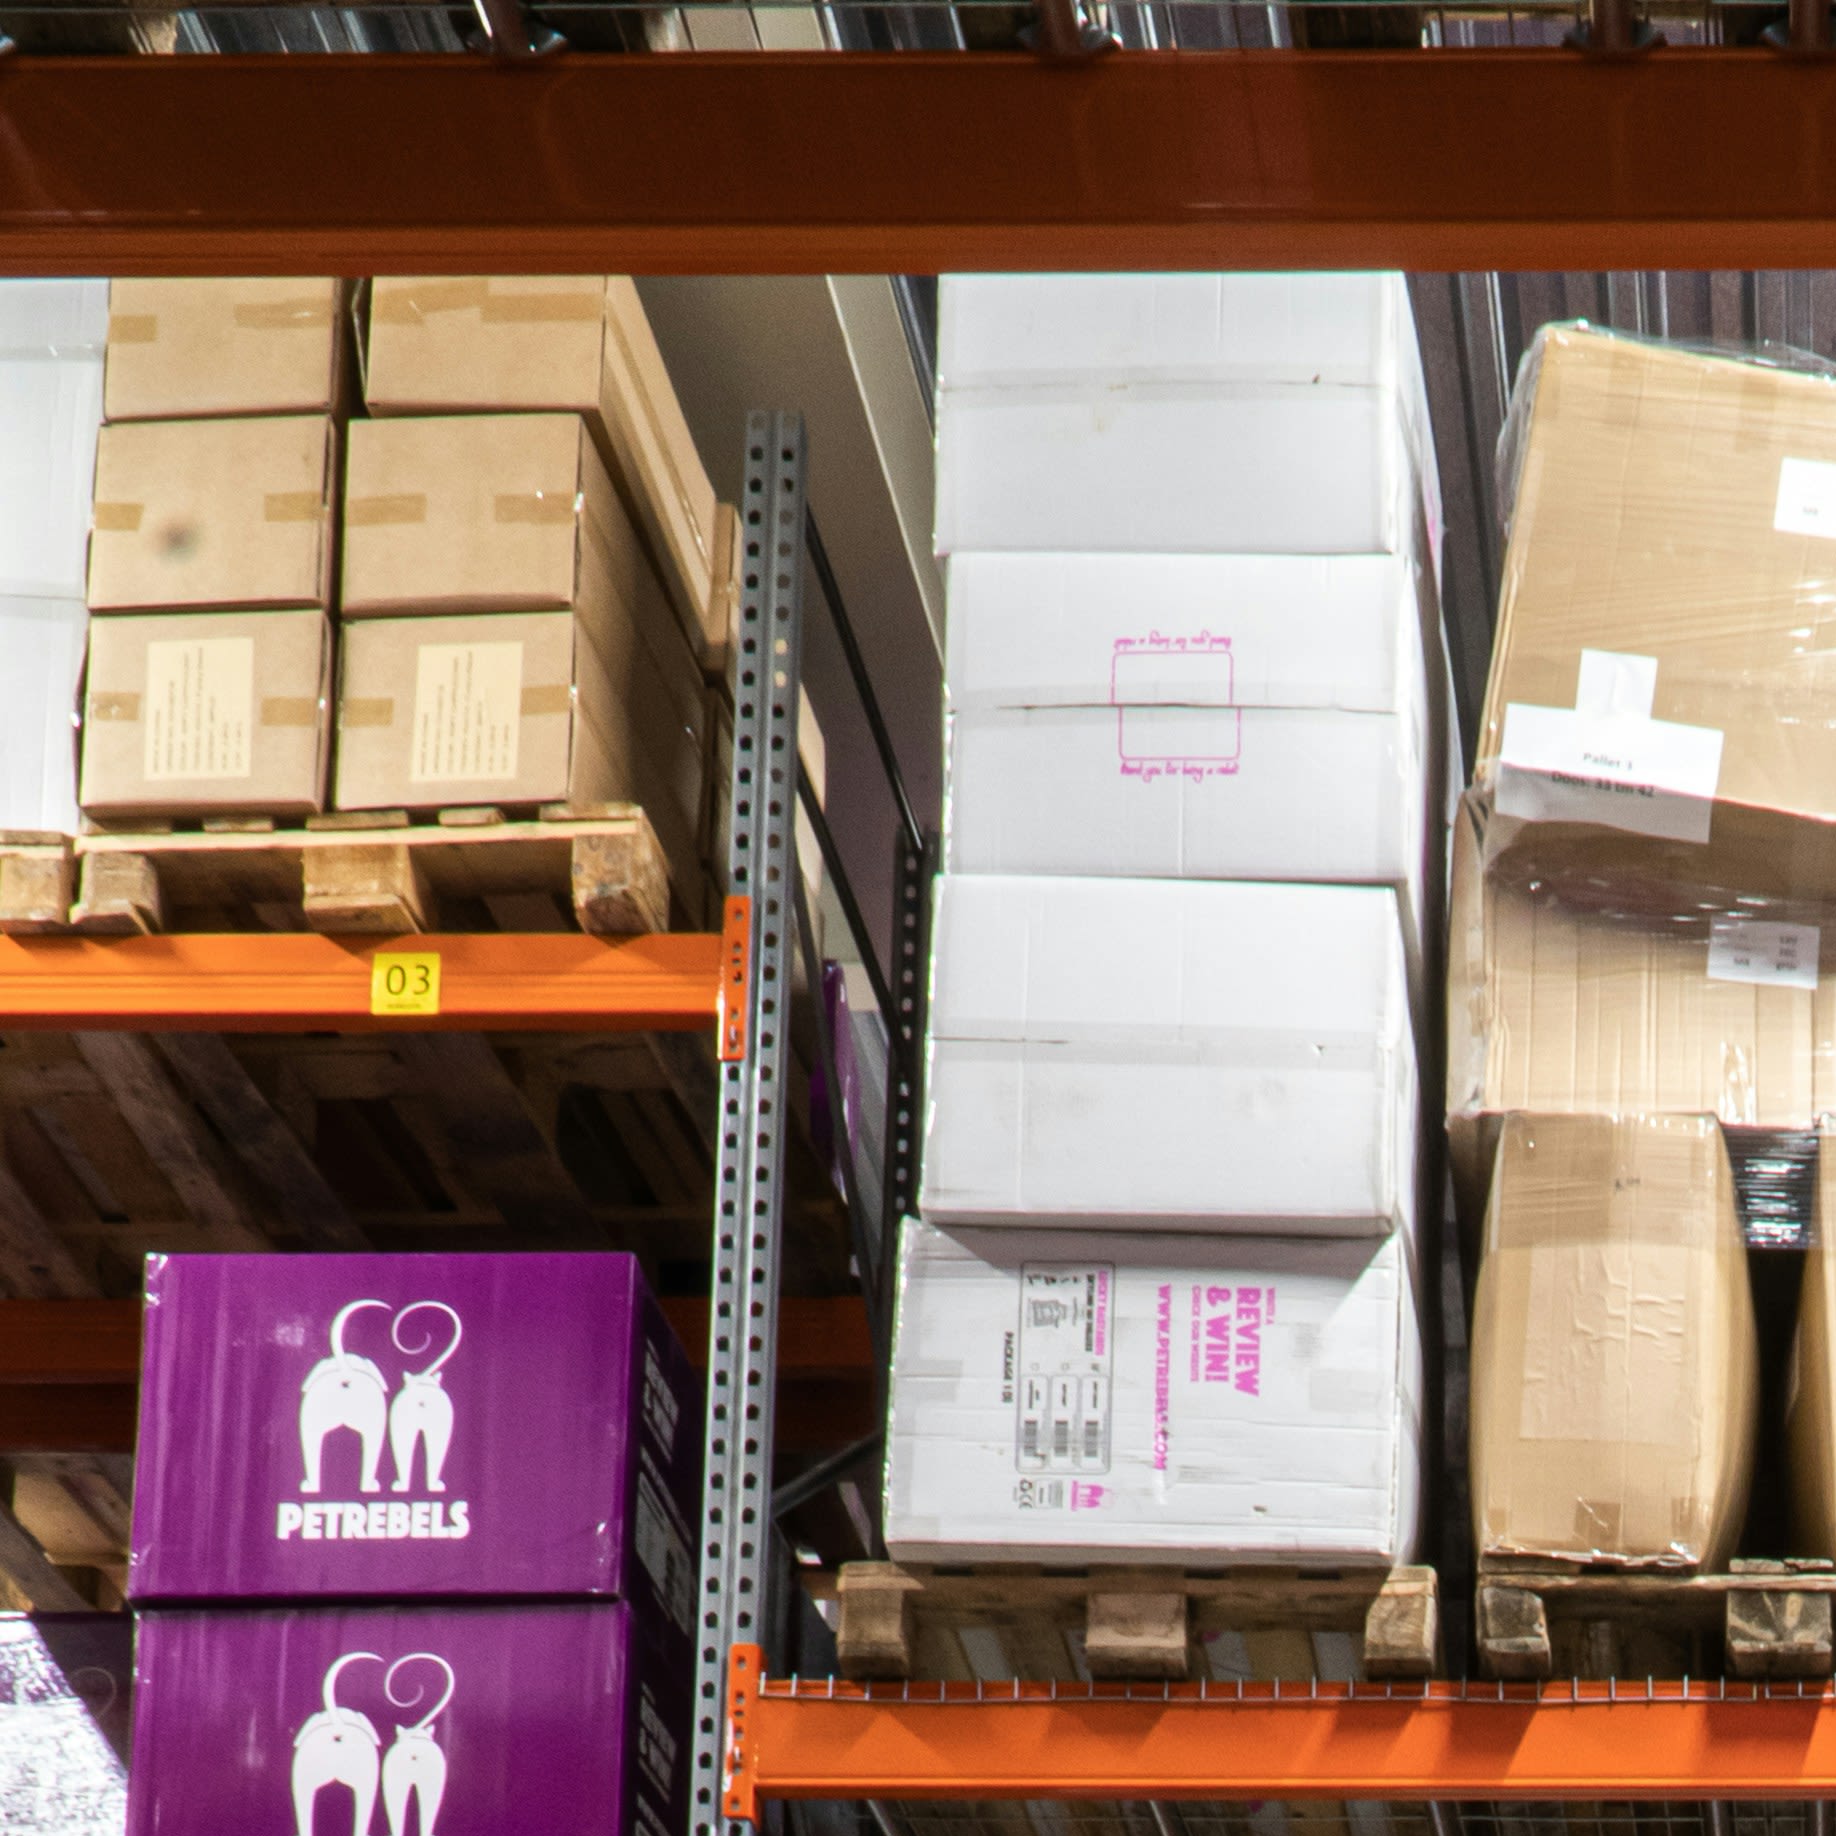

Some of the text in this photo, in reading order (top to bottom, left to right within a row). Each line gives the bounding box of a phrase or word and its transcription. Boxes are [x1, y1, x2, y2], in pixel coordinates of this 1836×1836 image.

[1583, 751, 1620, 769] Pallet
[384, 963, 431, 997] 03
[1204, 1285, 1231, 1383] & WIN!
[1233, 1285, 1262, 1398] REVIEW
[1152, 1284, 1173, 1472] WWW.PETREBELS.COM
[276, 1500, 472, 1541] PETREBELS
